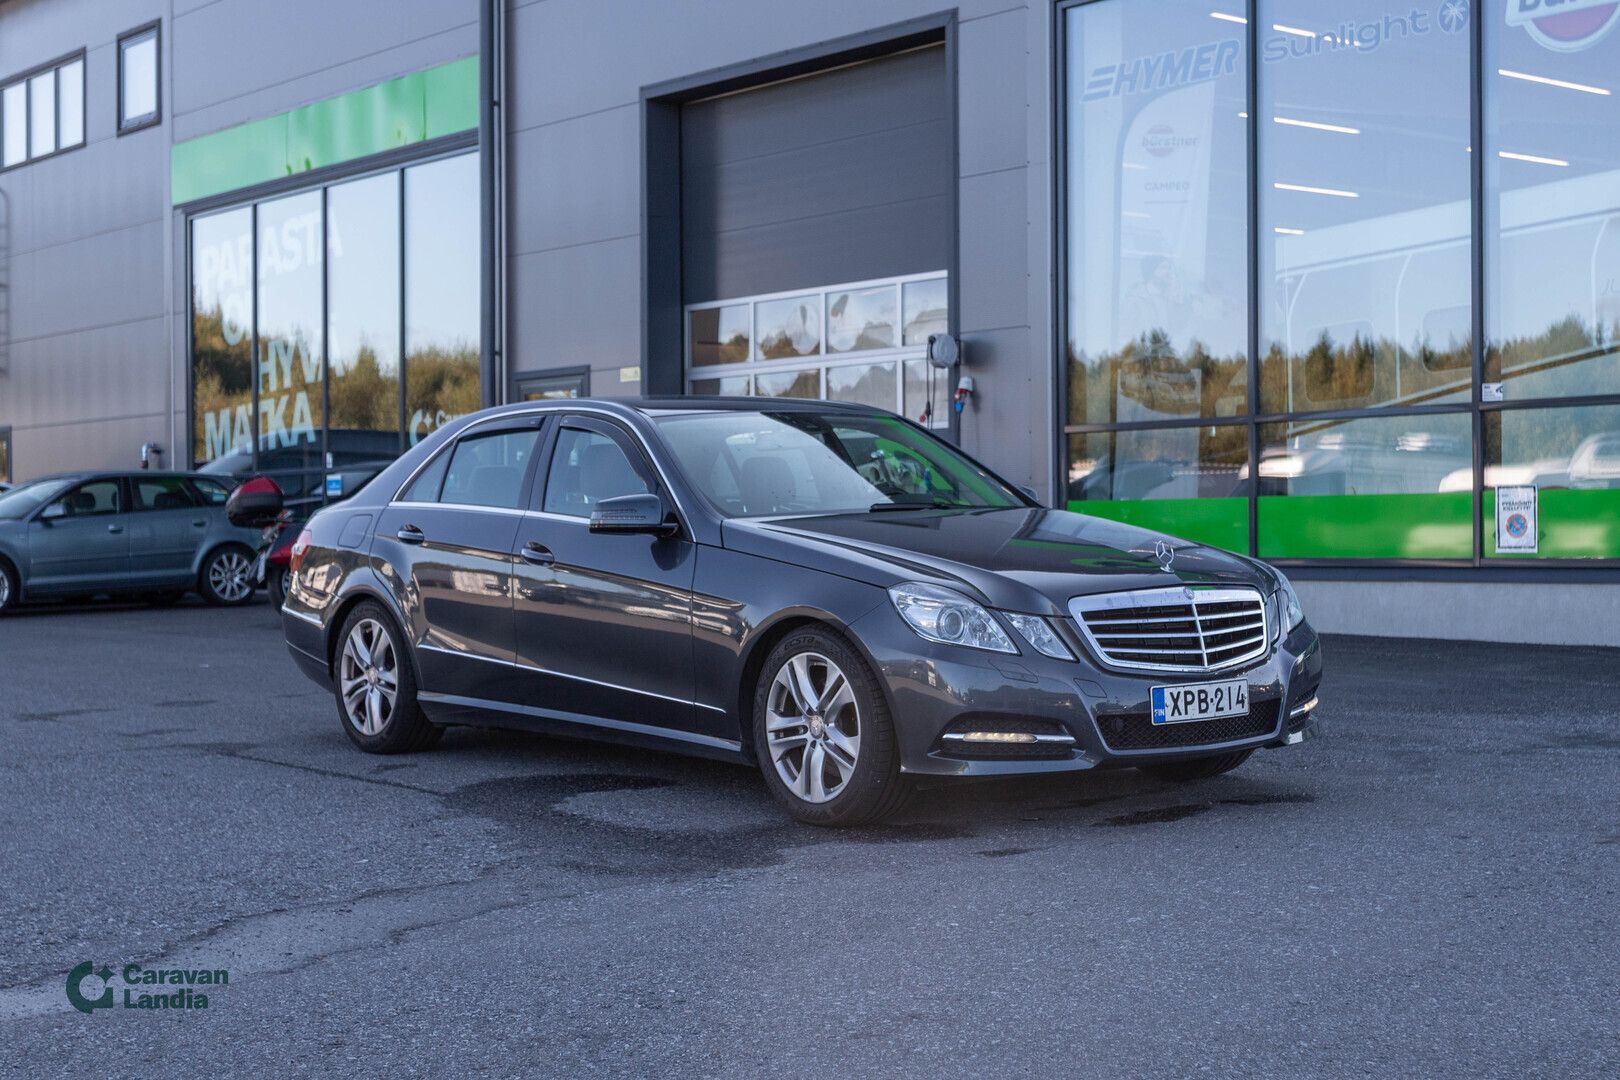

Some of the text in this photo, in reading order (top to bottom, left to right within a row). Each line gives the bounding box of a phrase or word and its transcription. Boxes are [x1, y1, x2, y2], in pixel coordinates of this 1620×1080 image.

[1264, 8, 1430, 62] Sunlight
[1112, 39, 1240, 97] HYMER
[204, 391, 316, 461] MATKA
